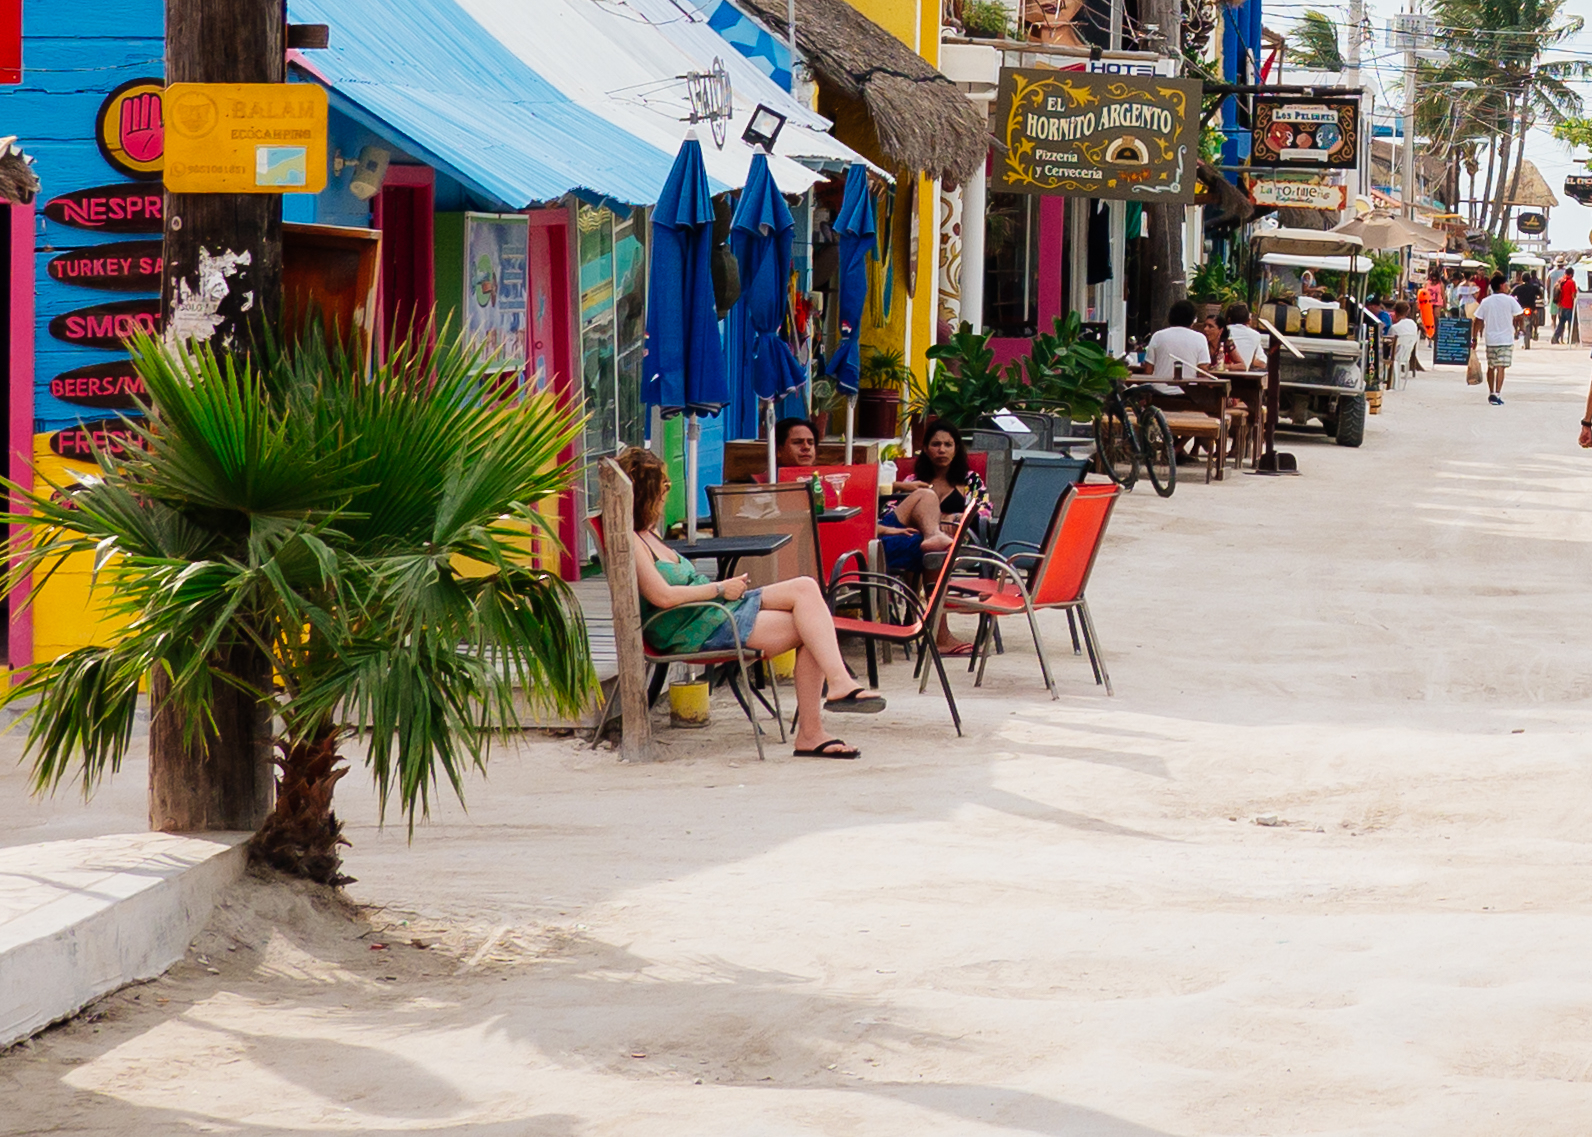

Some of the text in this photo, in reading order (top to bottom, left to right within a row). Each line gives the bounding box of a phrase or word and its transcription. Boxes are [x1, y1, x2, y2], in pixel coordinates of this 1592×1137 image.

[231, 101, 314, 119] BALAM
[1047, 97, 1065, 112] EL
[1098, 103, 1172, 134] ARGENTO
[231, 129, 311, 140] ECOCAMPING
[1035, 149, 1078, 162] Pizzería
[1035, 165, 1103, 179] y Cervecería
[54, 258, 132, 278] TURKEY
[65, 313, 161, 338] SMOO
[58, 430, 144, 455] FRESH
